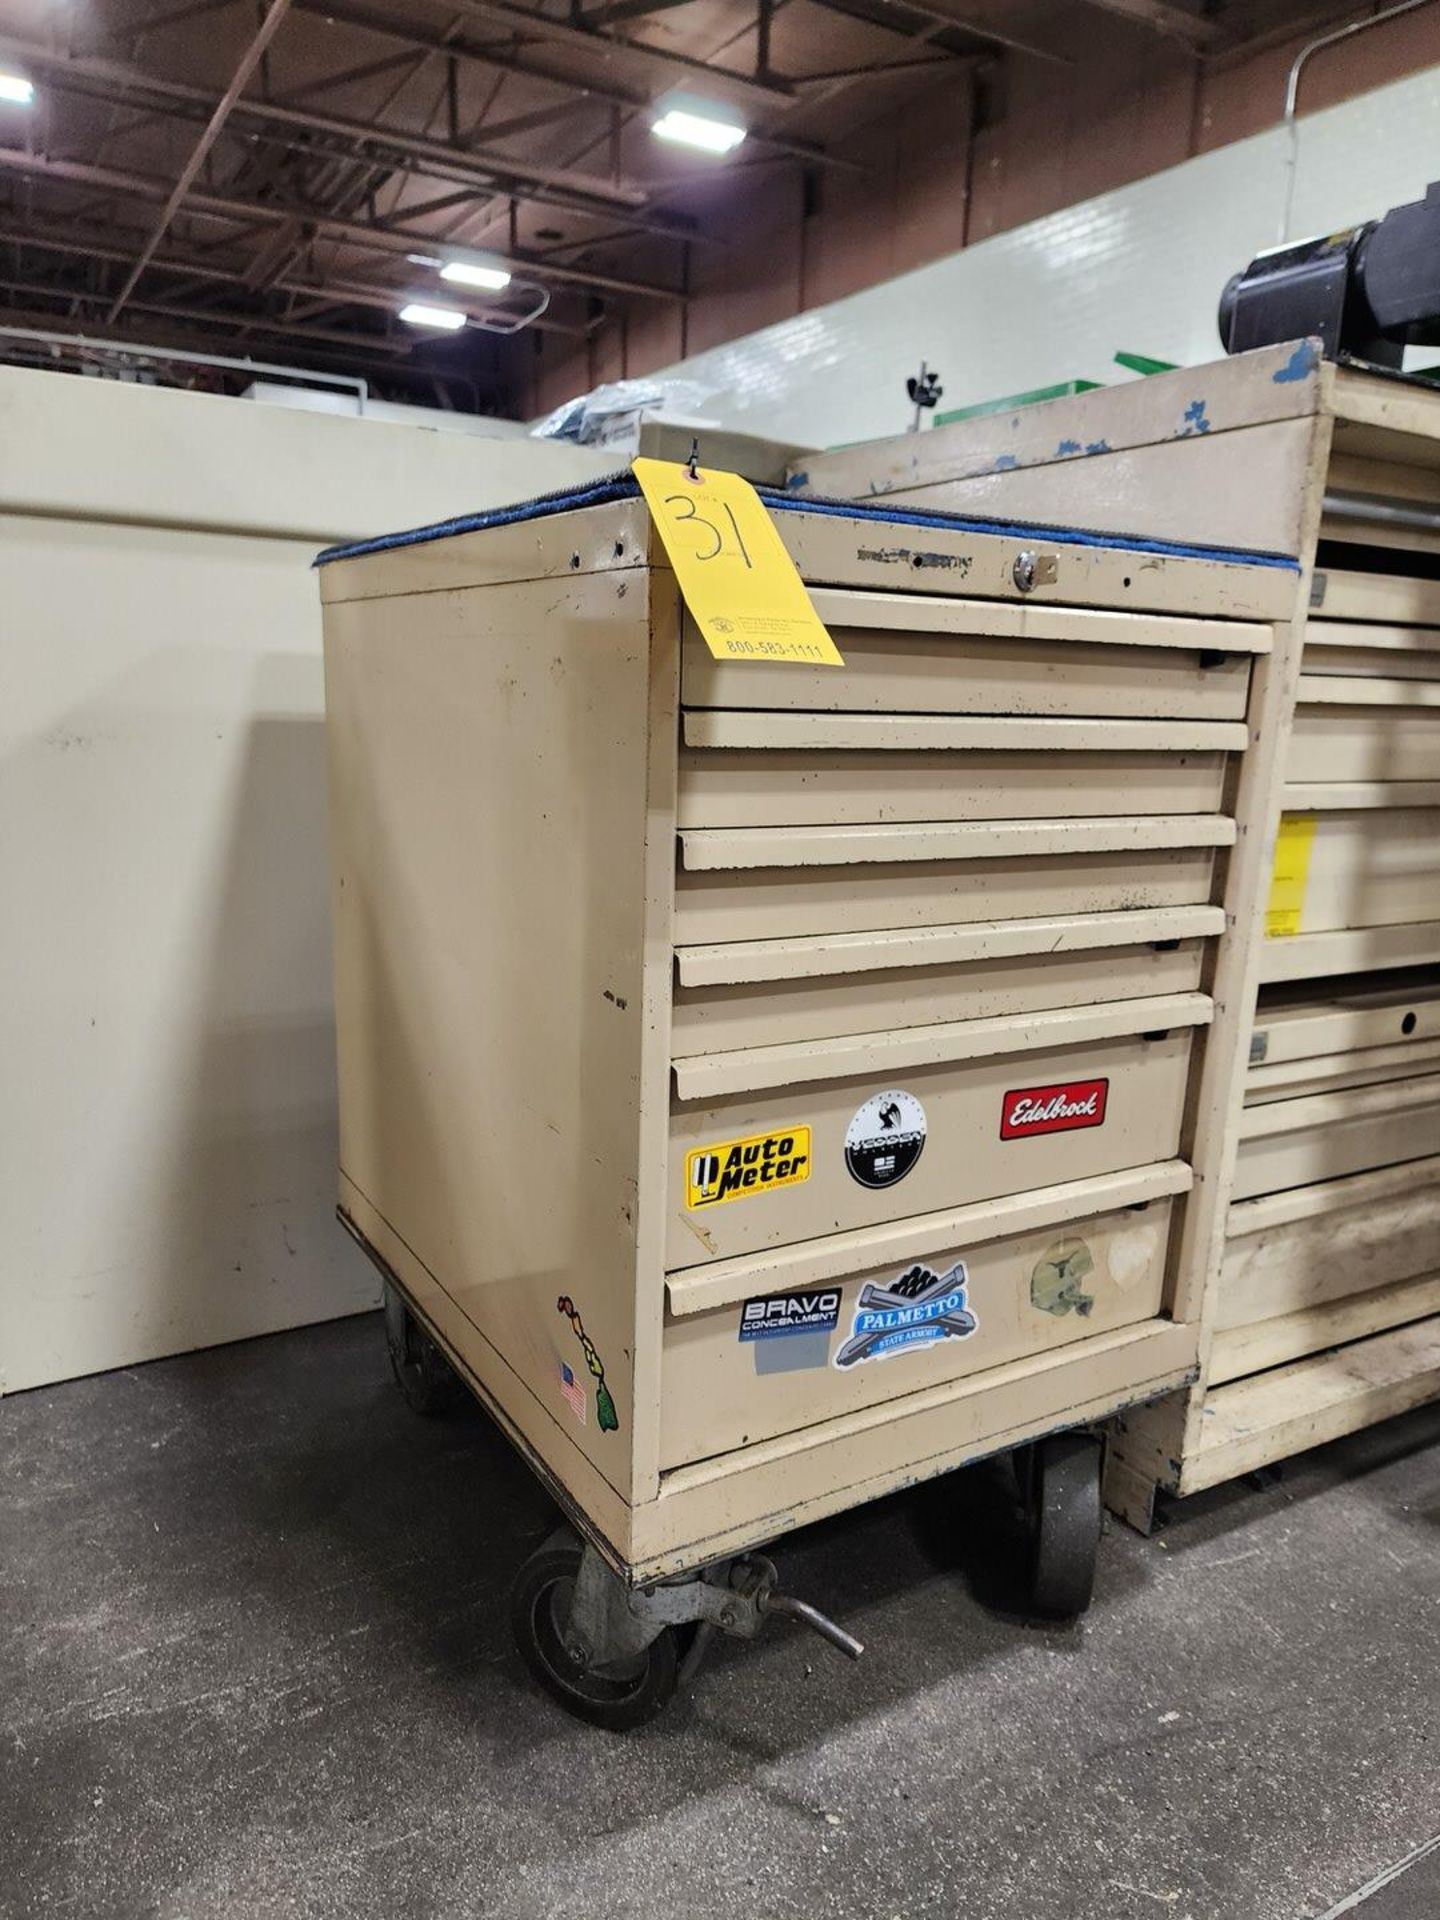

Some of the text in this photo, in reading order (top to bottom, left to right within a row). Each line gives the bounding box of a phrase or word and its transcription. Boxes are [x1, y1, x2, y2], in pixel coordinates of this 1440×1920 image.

[664, 495, 752, 568] 31
[727, 641, 823, 657] 800-583-1111
[1009, 1092, 1098, 1126] Edelbrock
[724, 1137, 794, 1170] Auto
[713, 1155, 807, 1200] Meter
[742, 1311, 837, 1330] CONCEALMENT
[744, 1294, 838, 1320] BRAVO
[861, 1295, 959, 1329] PALMETTO
[879, 1334, 904, 1349] STATE
